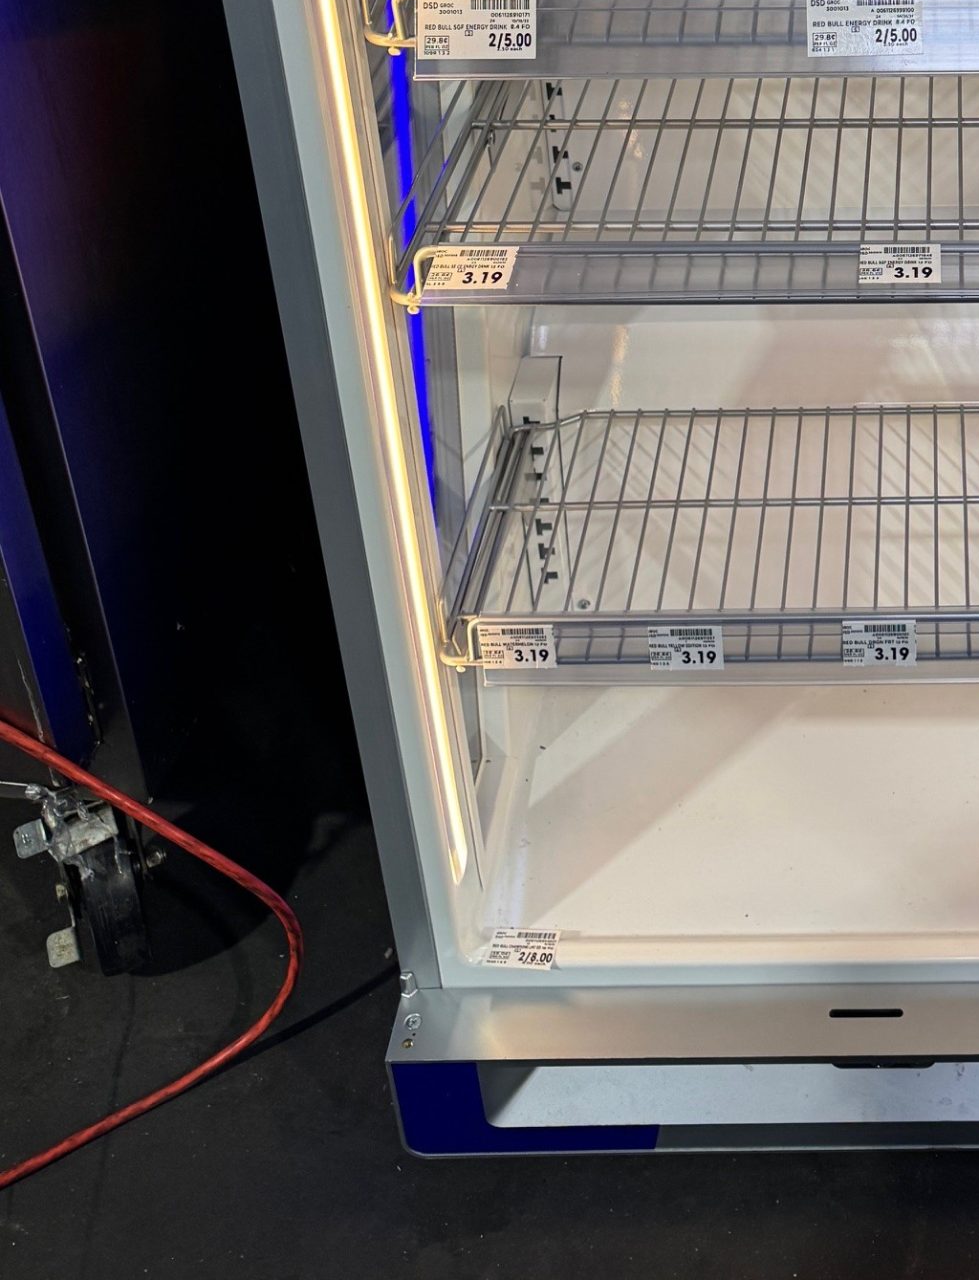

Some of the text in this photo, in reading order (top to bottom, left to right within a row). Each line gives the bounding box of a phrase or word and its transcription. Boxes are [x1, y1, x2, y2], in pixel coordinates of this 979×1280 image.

[488, 33, 532, 48] 2/5.00
[875, 28, 917, 43] 2/5.00
[462, 272, 503, 284] 3.19
[894, 267, 933, 278] 3.19
[514, 649, 549, 662] 3.19
[682, 651, 716, 664] 3.19
[875, 647, 909, 660] 3.19
